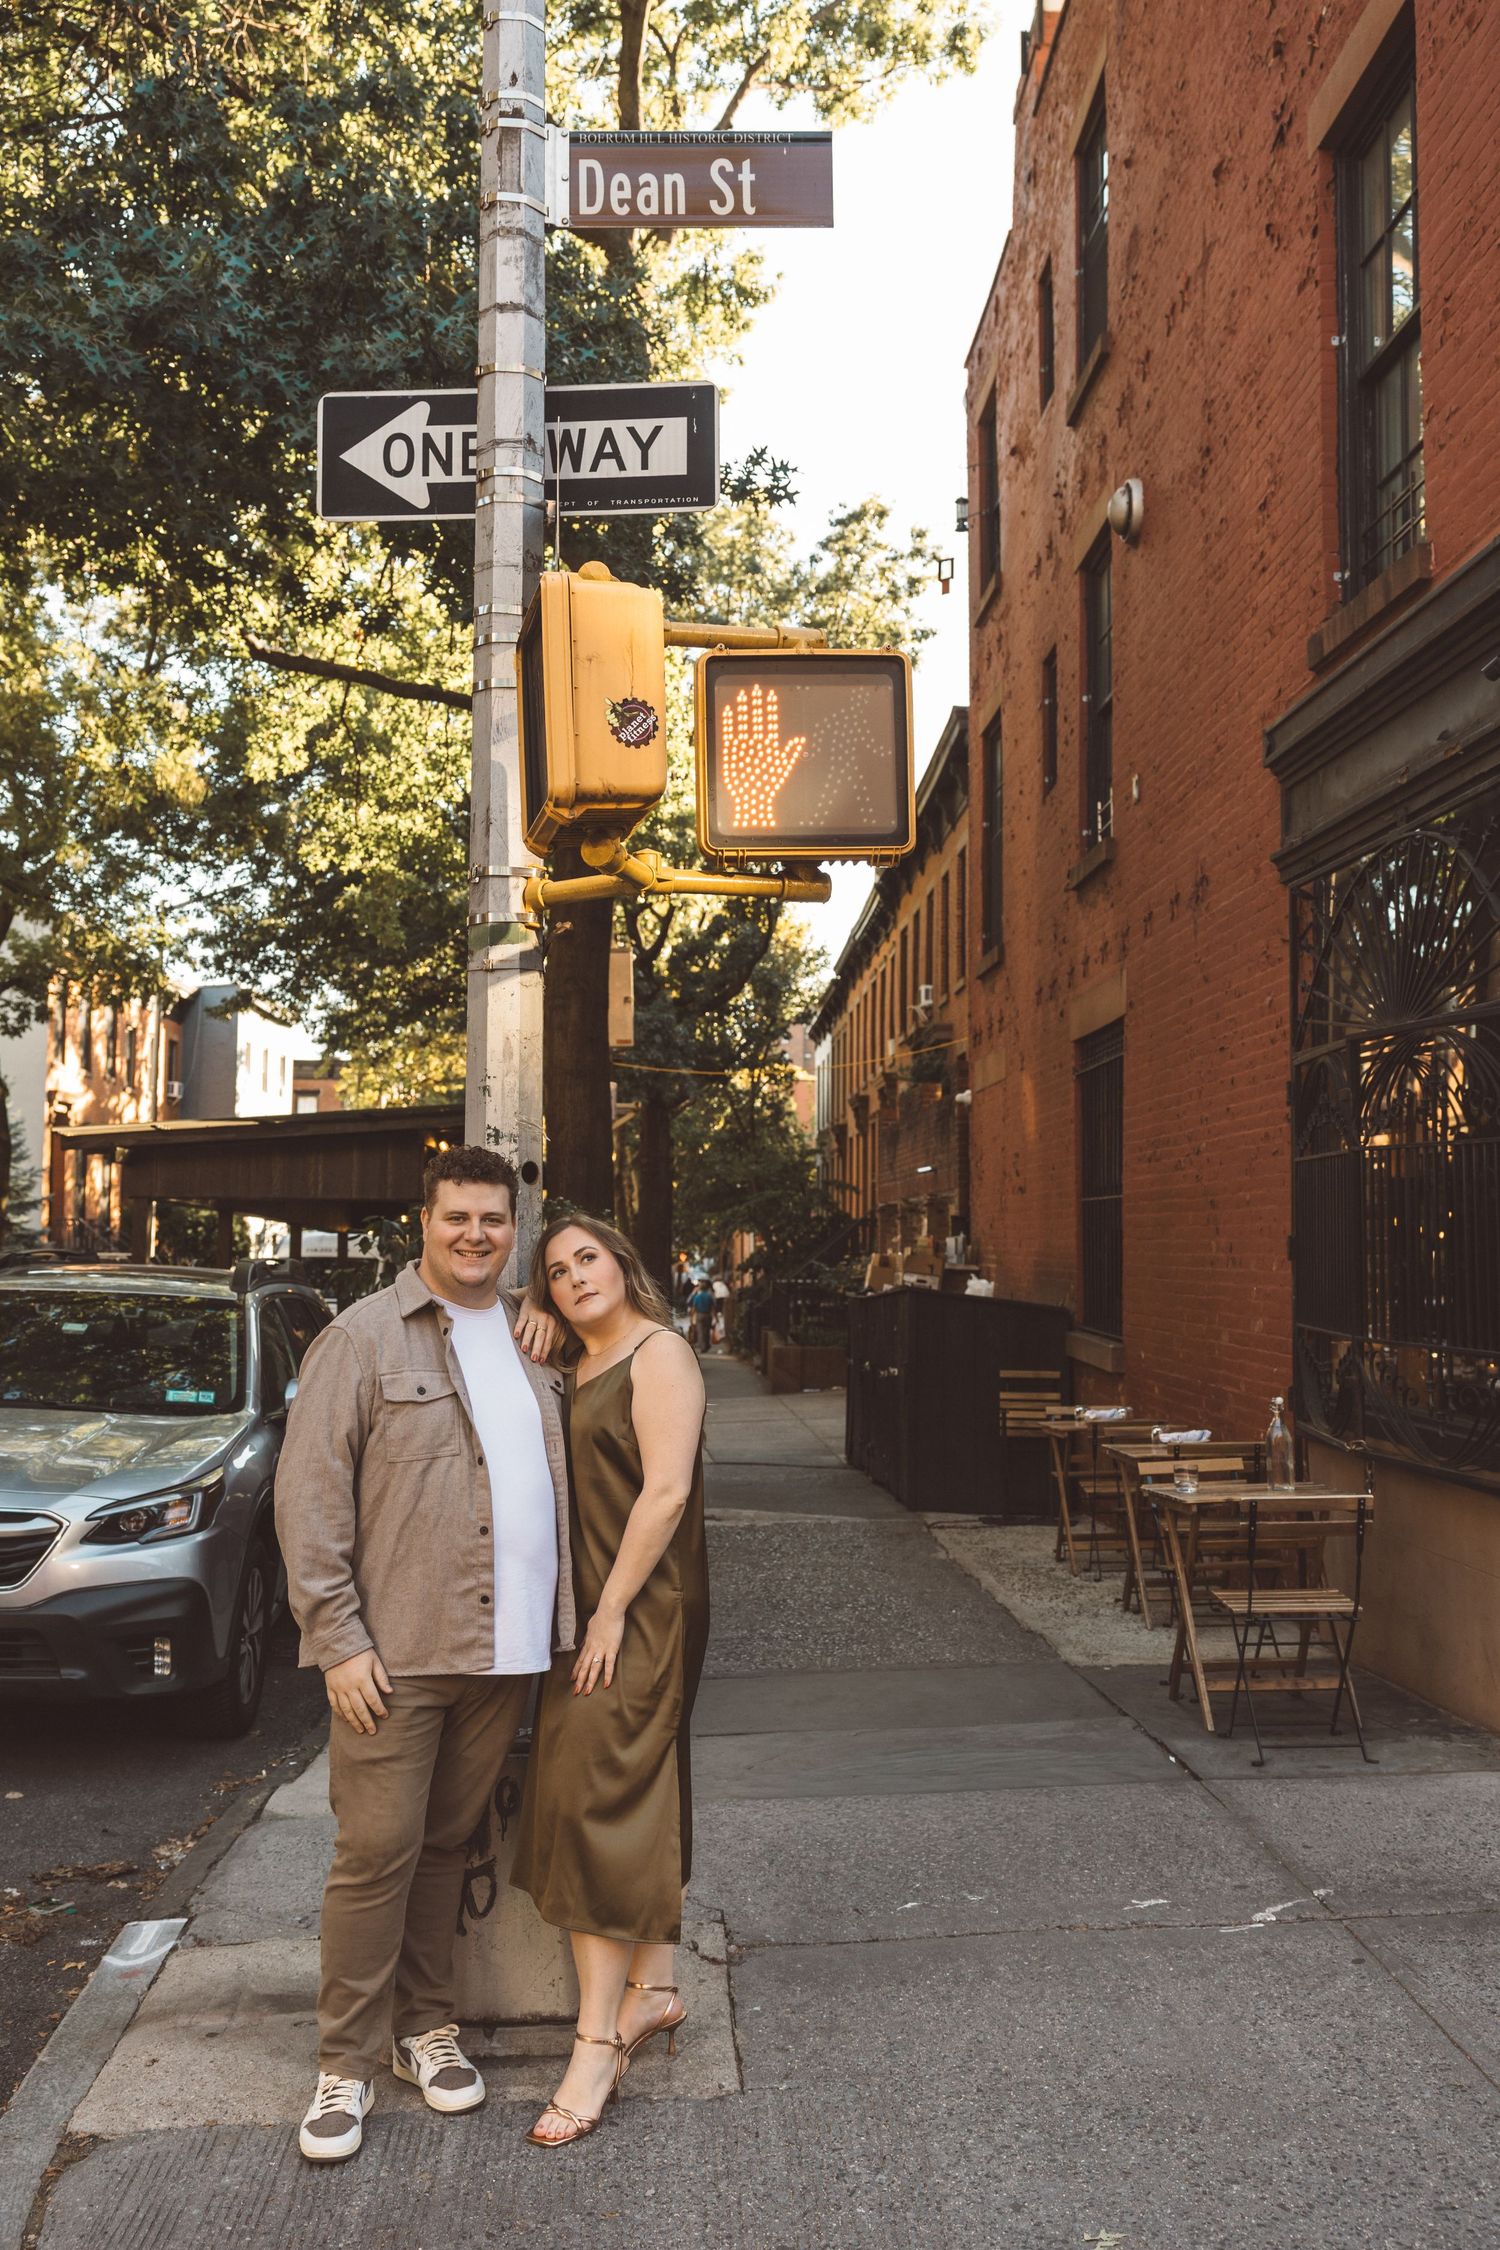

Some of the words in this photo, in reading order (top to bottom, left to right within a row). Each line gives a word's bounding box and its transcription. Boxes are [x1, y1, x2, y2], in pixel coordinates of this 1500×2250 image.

[579, 132, 635, 144] BOERUM
[669, 132, 730, 144] HISTORIC
[734, 132, 794, 144] DISTRICT
[578, 158, 686, 216] Dean
[709, 157, 756, 216] St
[382, 431, 477, 478] ONE
[546, 425, 664, 474] WAY
[610, 496, 700, 505] TRANSPORTATION
[618, 711, 647, 742] planet
[626, 714, 657, 743] fitness
